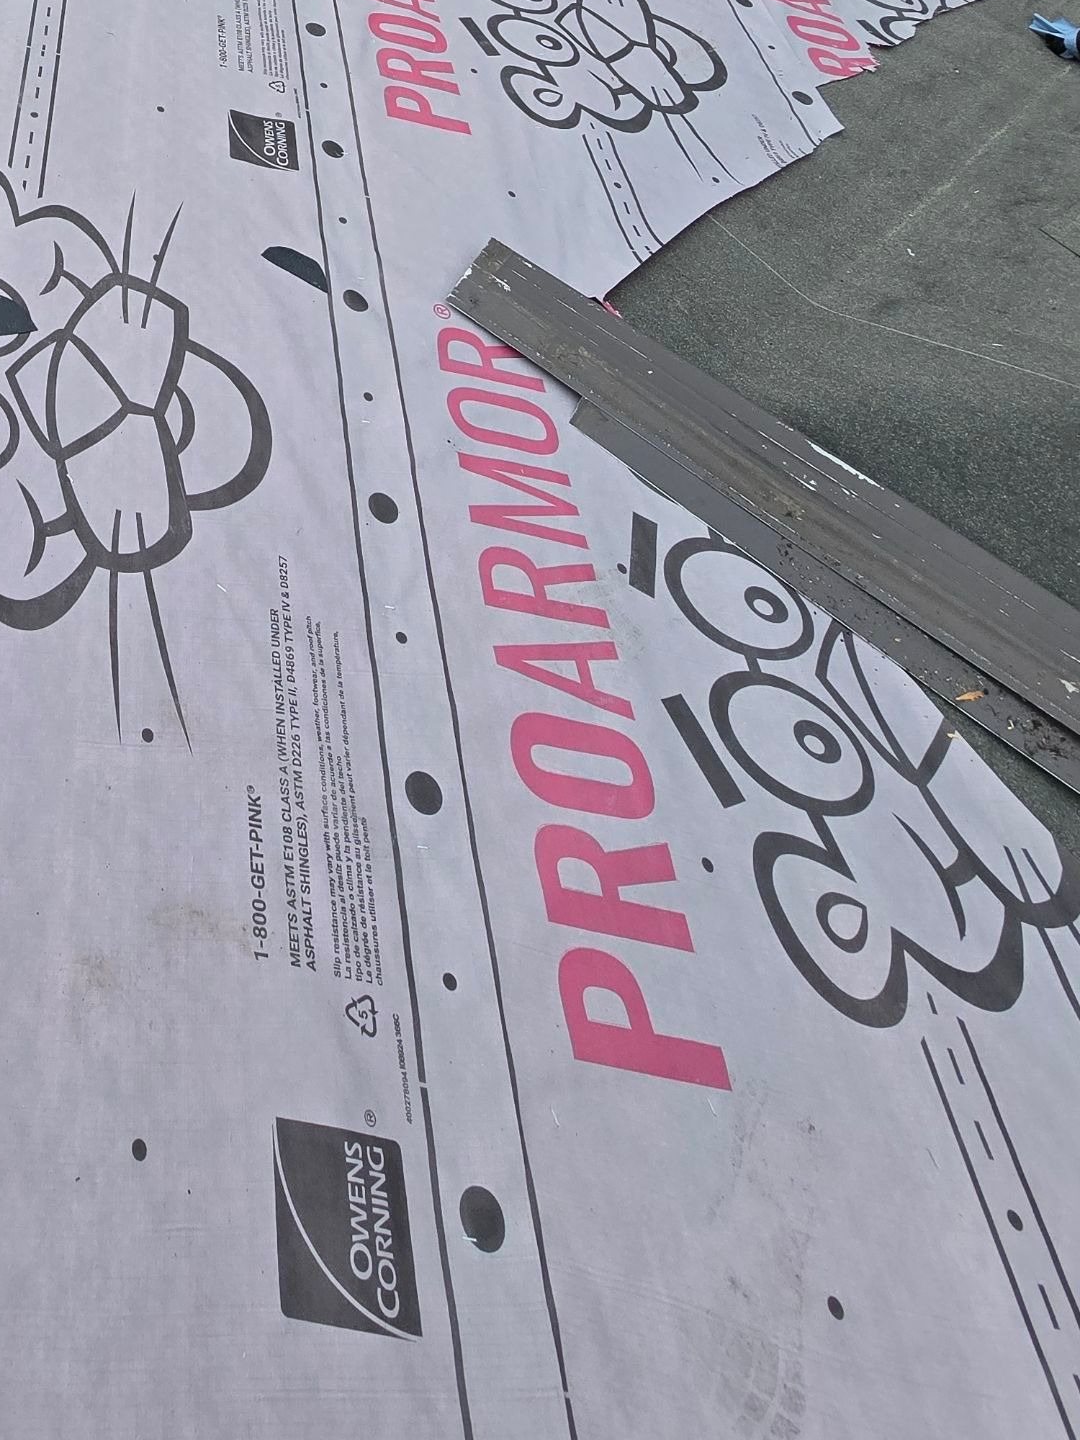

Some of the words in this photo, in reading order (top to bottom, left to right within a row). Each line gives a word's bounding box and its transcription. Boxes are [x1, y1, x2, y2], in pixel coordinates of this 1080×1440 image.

[263, 120, 276, 157] OWENS
[277, 554, 290, 589] D8257
[268, 608, 281, 647] UNDER
[281, 614, 293, 643] TYPE
[271, 650, 285, 715] INSTALLED
[283, 645, 296, 683] D4869
[287, 698, 299, 730] TYPE
[275, 718, 288, 762] (WHEN
[290, 734, 302, 766] D226
[342, 746, 352, 771] varier
[279, 777, 291, 822] CLASS
[292, 769, 305, 810] ASTM
[318, 794, 329, 829] surface
[282, 825, 294, 861] E108
[295, 814, 312, 894] SHINGLES),
[331, 832, 343, 862] puede
[284, 863, 297, 910] ASTM
[327, 875, 337, 897] may
[287, 912, 300, 968] MEETS
[301, 896, 316, 972] ASPHALT
[327, 899, 339, 954] resistance
[337, 906, 350, 963] resistencia
[347, 903, 359, 942] calzado
[331, 956, 343, 978] Slip
[353, 960, 365, 982] tipo
[369, 924, 382, 986] chaussures
[344, 1140, 373, 1280] OWENS
